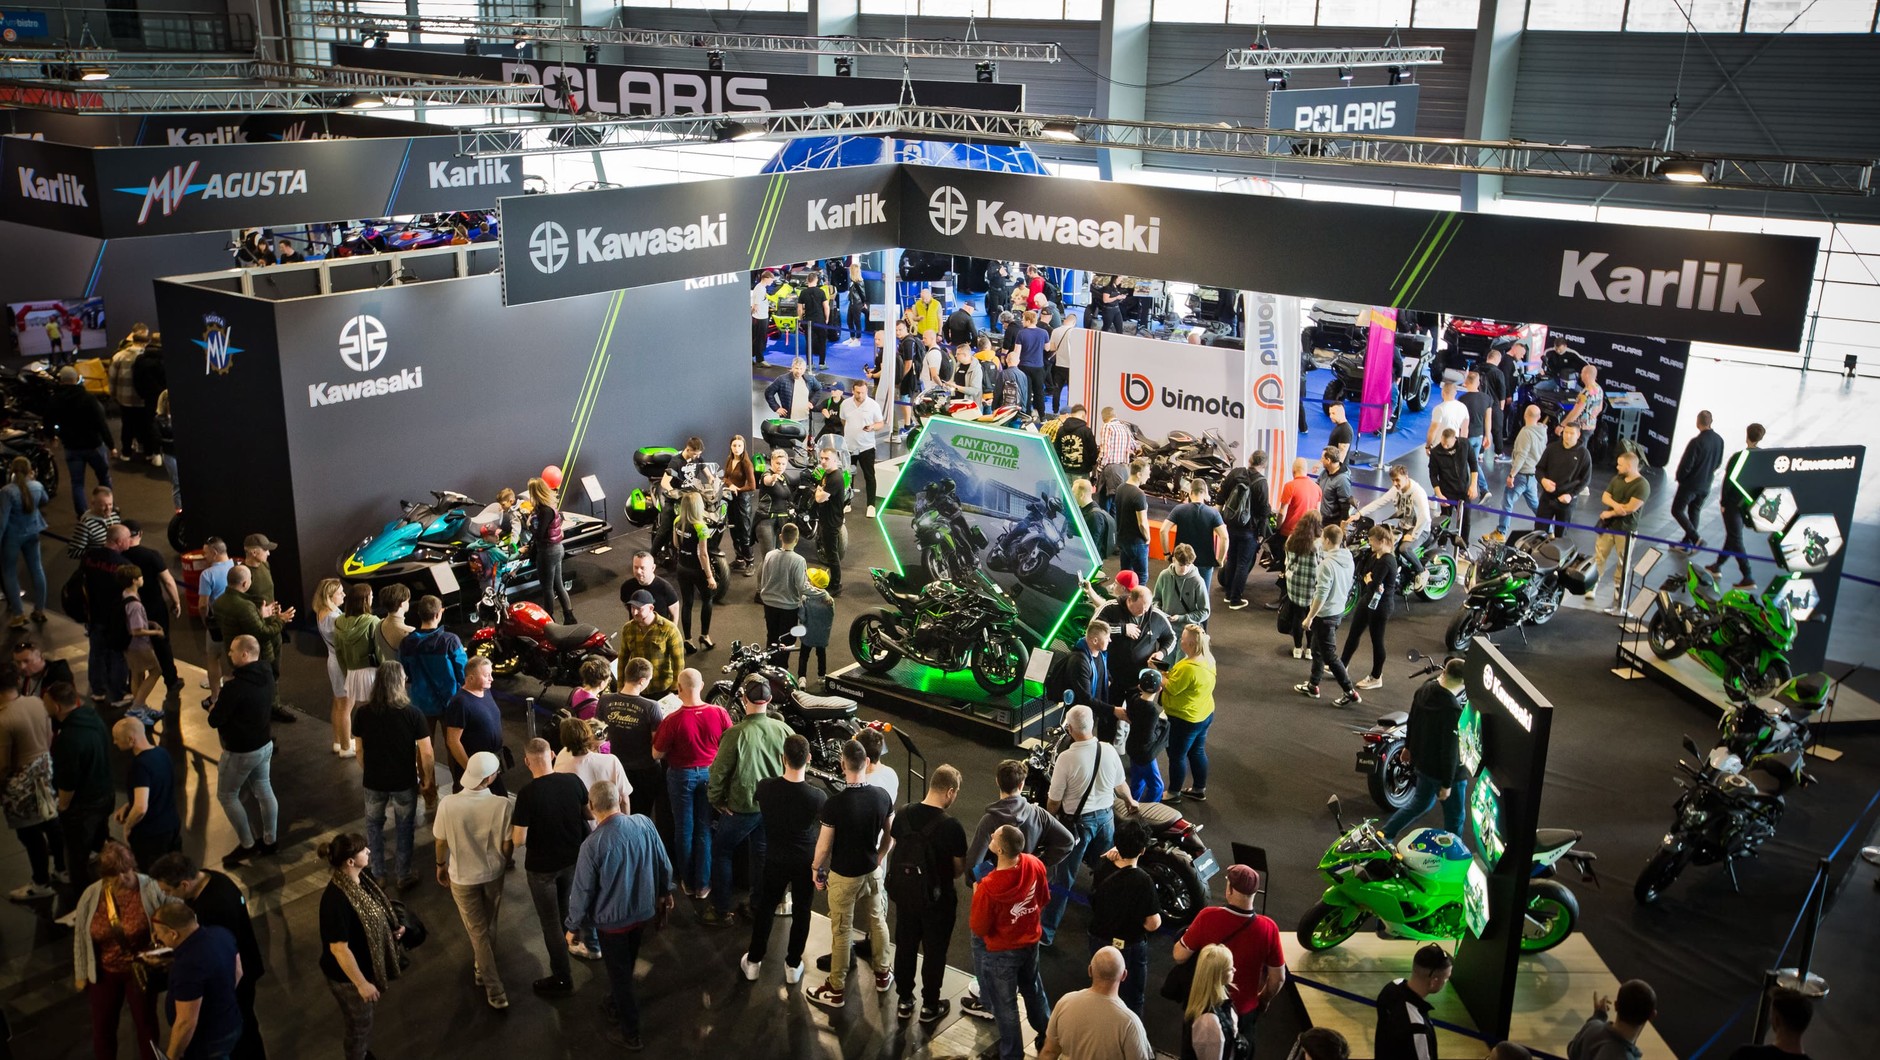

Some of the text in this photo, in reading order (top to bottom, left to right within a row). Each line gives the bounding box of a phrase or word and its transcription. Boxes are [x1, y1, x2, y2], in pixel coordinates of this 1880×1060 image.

[502, 62, 771, 124] POLARIS
[1295, 100, 1397, 133] POLARIS
[166, 125, 249, 146] Karlik
[18, 166, 89, 208] Karlik
[428, 158, 512, 189] Karlik
[137, 160, 308, 225] MV AGUSTA
[807, 193, 887, 232] Karlik
[976, 199, 1161, 254] Kawasaki
[577, 213, 728, 264] Kawasaki
[1557, 249, 1766, 316] Karlik
[1258, 295, 1279, 366] bimot
[1611, 343, 1643, 357] POLARIS
[1660, 356, 1684, 369] POLARIS
[308, 366, 423, 408] Kawasaki
[1605, 378, 1637, 392] POLARIS
[1635, 367, 1660, 381] POLARIS
[1161, 386, 1245, 419] bimota
[1653, 392, 1677, 407] POLARIS
[956, 437, 1014, 457] ANY ROAD.
[1647, 429, 1669, 445] POLARIS
[966, 451, 1020, 470] ANY TIME.
[1790, 456, 1856, 471] Kawasaki
[836, 684, 864, 698] Kawasaki
[1491, 676, 1533, 733] Kawasaki
[607, 710, 640, 723] Indian
